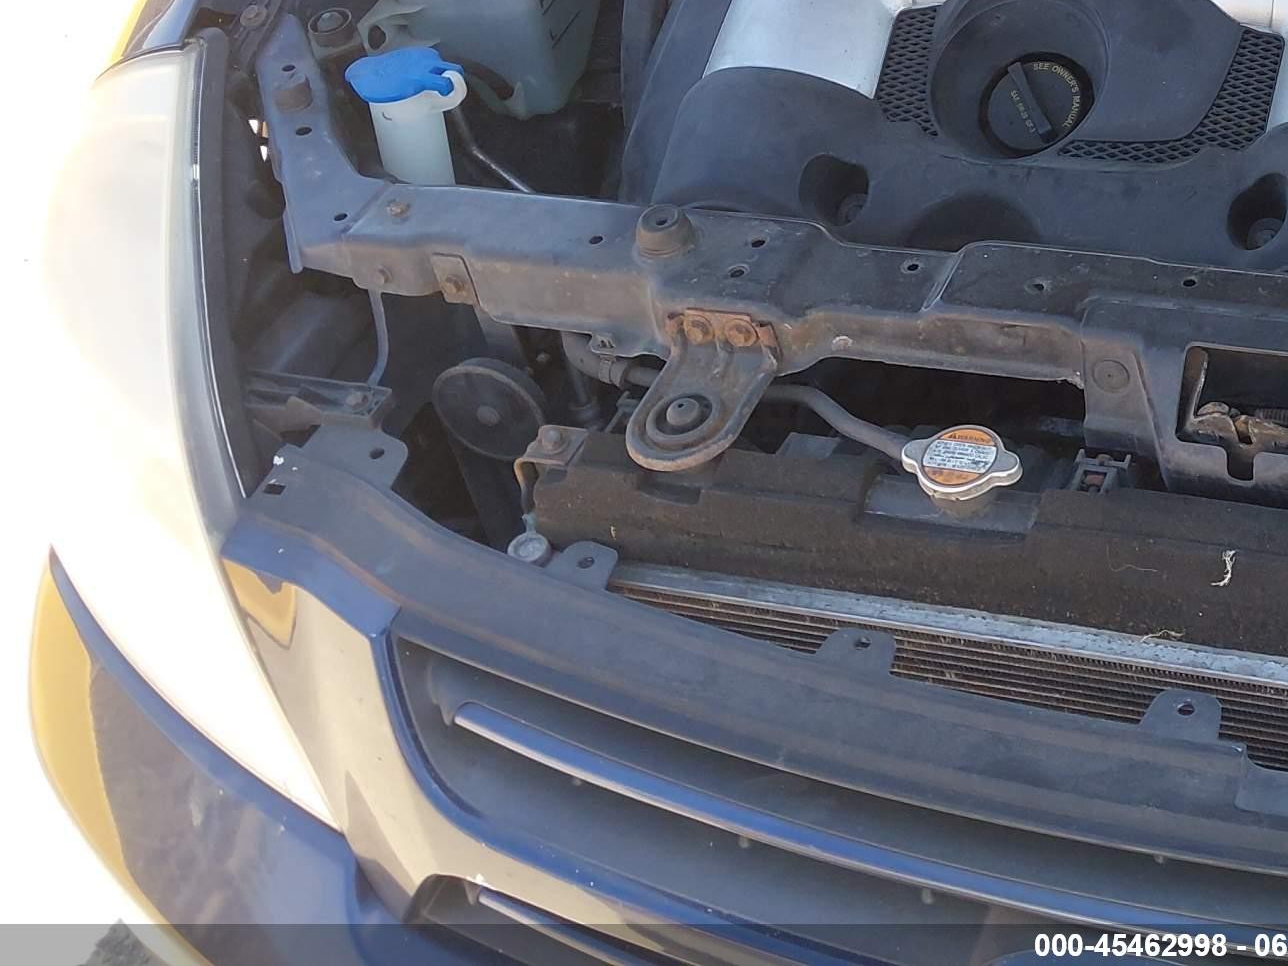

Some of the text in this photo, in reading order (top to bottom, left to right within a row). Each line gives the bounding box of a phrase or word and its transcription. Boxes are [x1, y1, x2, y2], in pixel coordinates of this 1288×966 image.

[1033, 62, 1081, 128] SEE OWNER'S MANUAL
